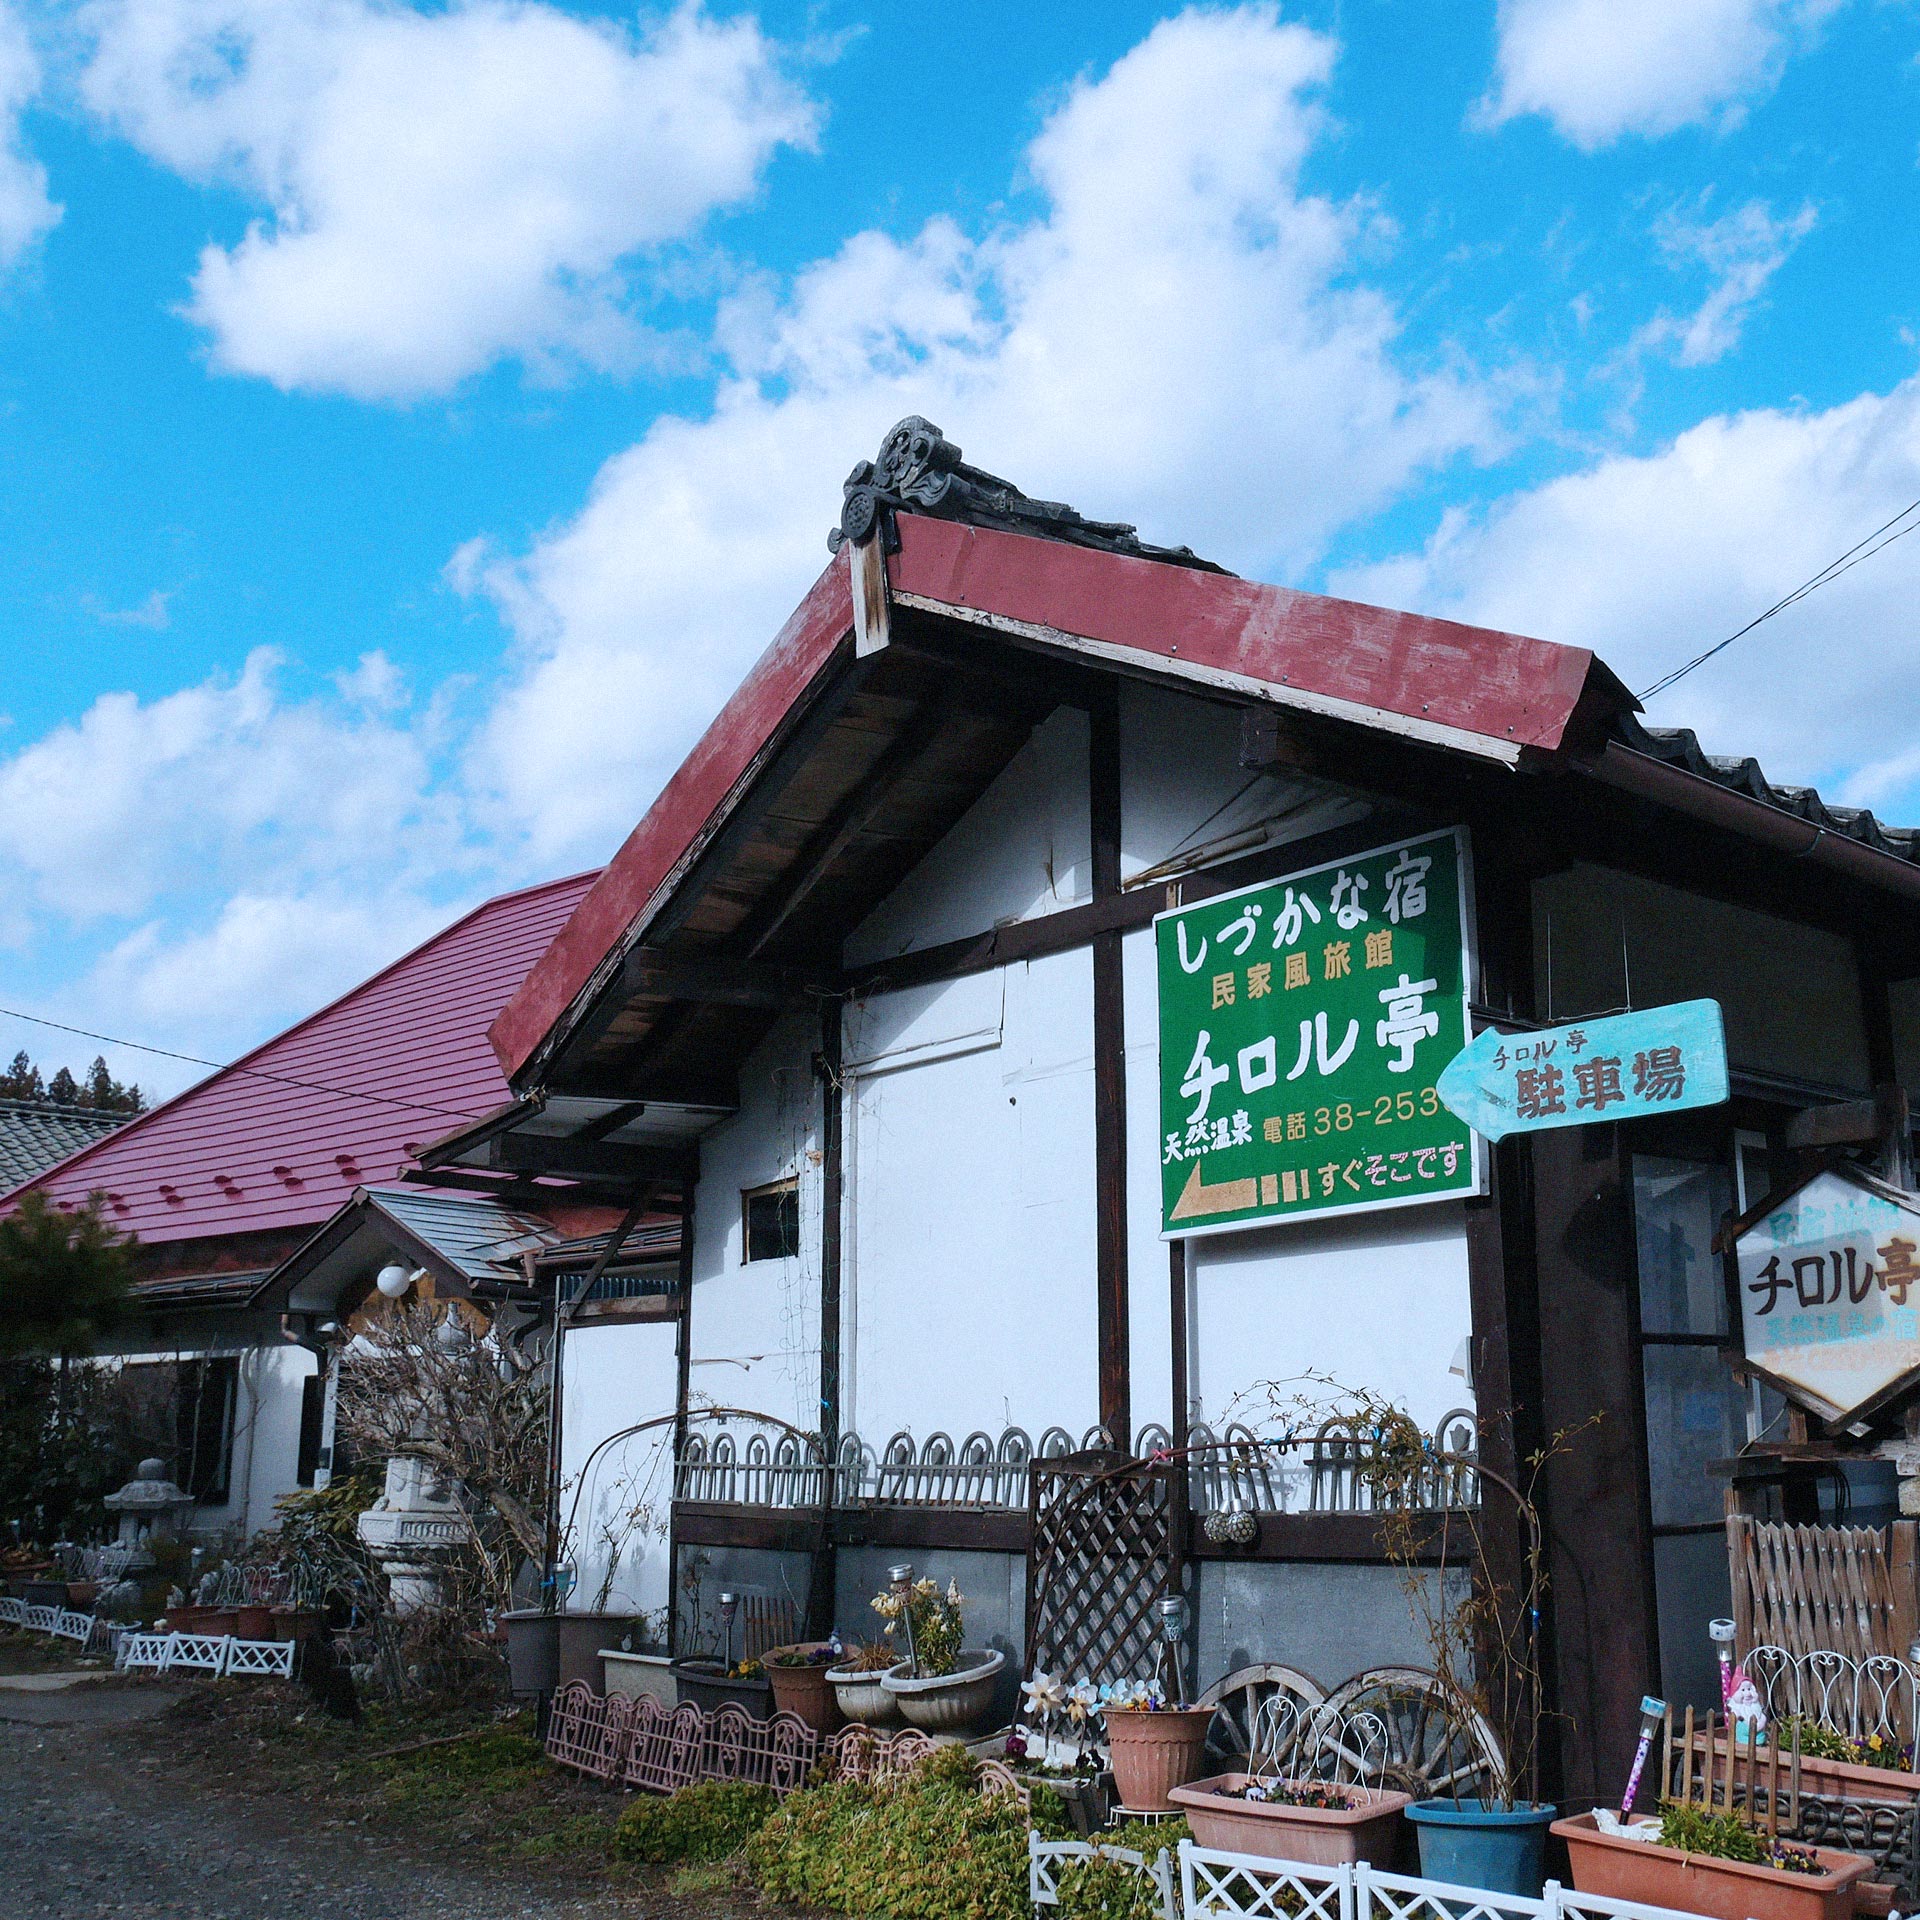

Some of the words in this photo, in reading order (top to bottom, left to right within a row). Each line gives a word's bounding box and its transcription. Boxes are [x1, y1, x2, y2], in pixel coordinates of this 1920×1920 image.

[1177, 850, 1432, 974] しづかな宿
[1211, 929, 1394, 1010] 民家風旅館
[1179, 974, 1439, 1124] チロル亭
[1493, 1029, 1588, 1071] チロル亭
[1515, 1045, 1686, 1119] 駐車場
[1161, 1109, 1253, 1165] 天然温泉
[1263, 1111, 1306, 1144] 電話
[1313, 1086, 1451, 1136] 38-253
[1317, 1141, 1464, 1197] すぐそこです
[1748, 1237, 1920, 1316] チロル亭
